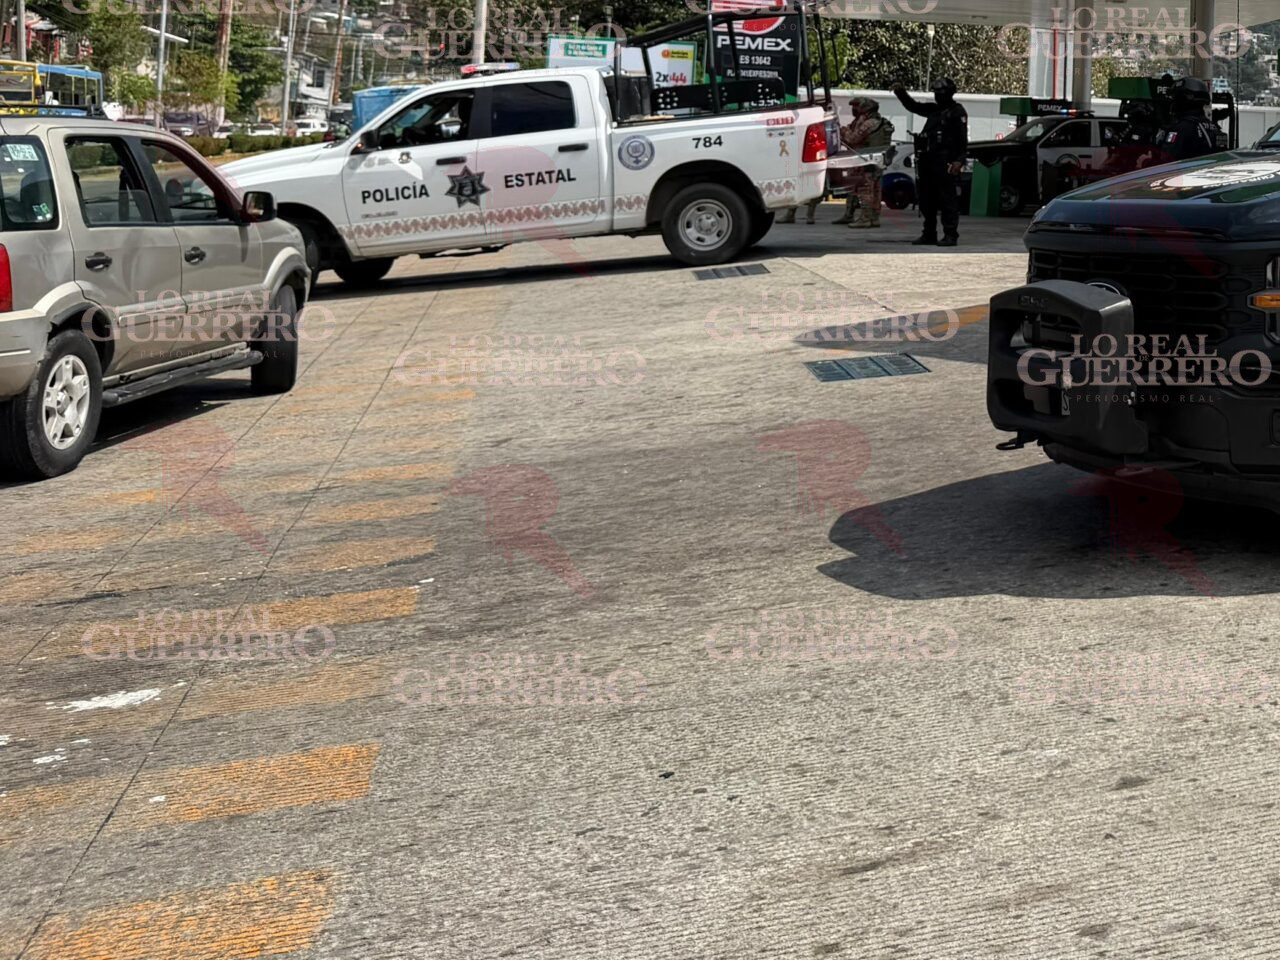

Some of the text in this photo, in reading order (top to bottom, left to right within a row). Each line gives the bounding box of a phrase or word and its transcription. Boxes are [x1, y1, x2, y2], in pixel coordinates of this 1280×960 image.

[716, 35, 792, 51] PEMEX
[692, 135, 724, 149] 784
[504, 168, 577, 189] ESTATAL
[362, 181, 430, 204] POLICÍA
